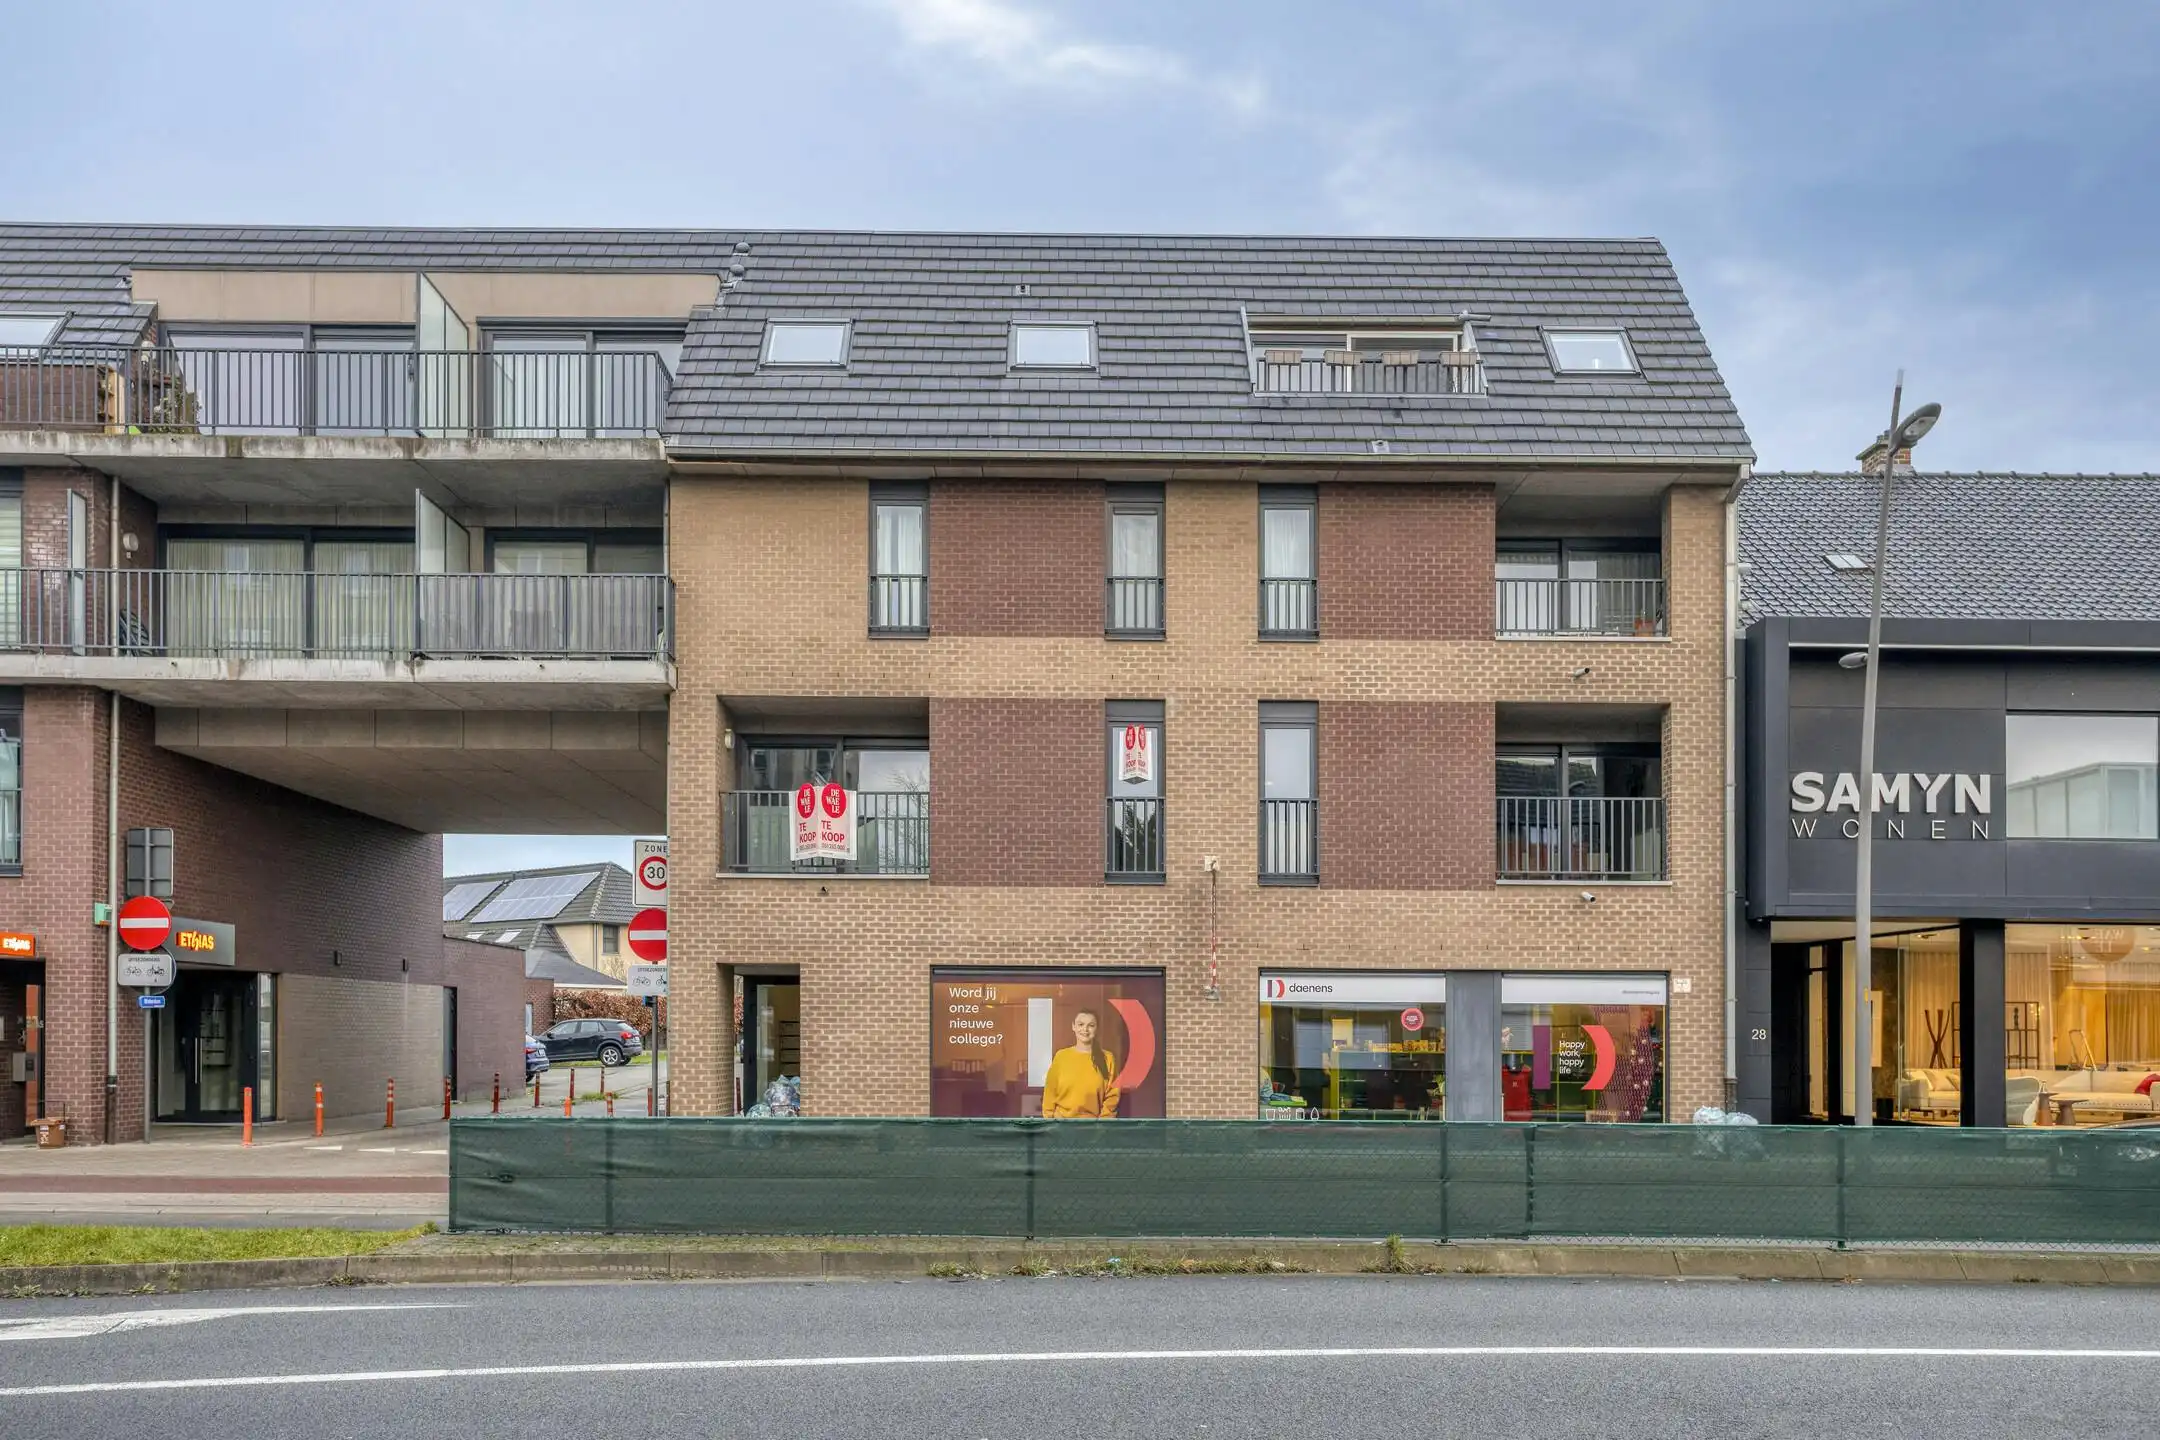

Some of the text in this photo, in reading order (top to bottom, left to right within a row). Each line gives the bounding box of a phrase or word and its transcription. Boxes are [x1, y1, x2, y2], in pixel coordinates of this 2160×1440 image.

[830, 788, 840, 797] DE
[1791, 772, 1991, 814] SAMYN
[826, 796, 840, 805] WAE
[831, 805, 840, 814] LE
[799, 822, 807, 832] TE
[821, 820, 831, 830] TE
[1791, 818, 1989, 839] WONEN
[799, 832, 817, 843] KOOP
[821, 832, 845, 843] KOOP
[645, 845, 667, 853] ZONE
[647, 866, 665, 880] 30
[1289, 983, 1333, 993] daenens
[949, 987, 996, 1001] Word jij
[949, 1004, 979, 1013] onze
[949, 1018, 994, 1029] nieuwe
[1751, 1028, 1767, 1040] 28
[949, 1033, 1003, 1047] collega?
[1559, 1040, 1586, 1050] Happy
[1559, 1049, 1580, 1057] work,
[1559, 1057, 1584, 1067] happy
[1559, 1066, 1571, 1074] life
